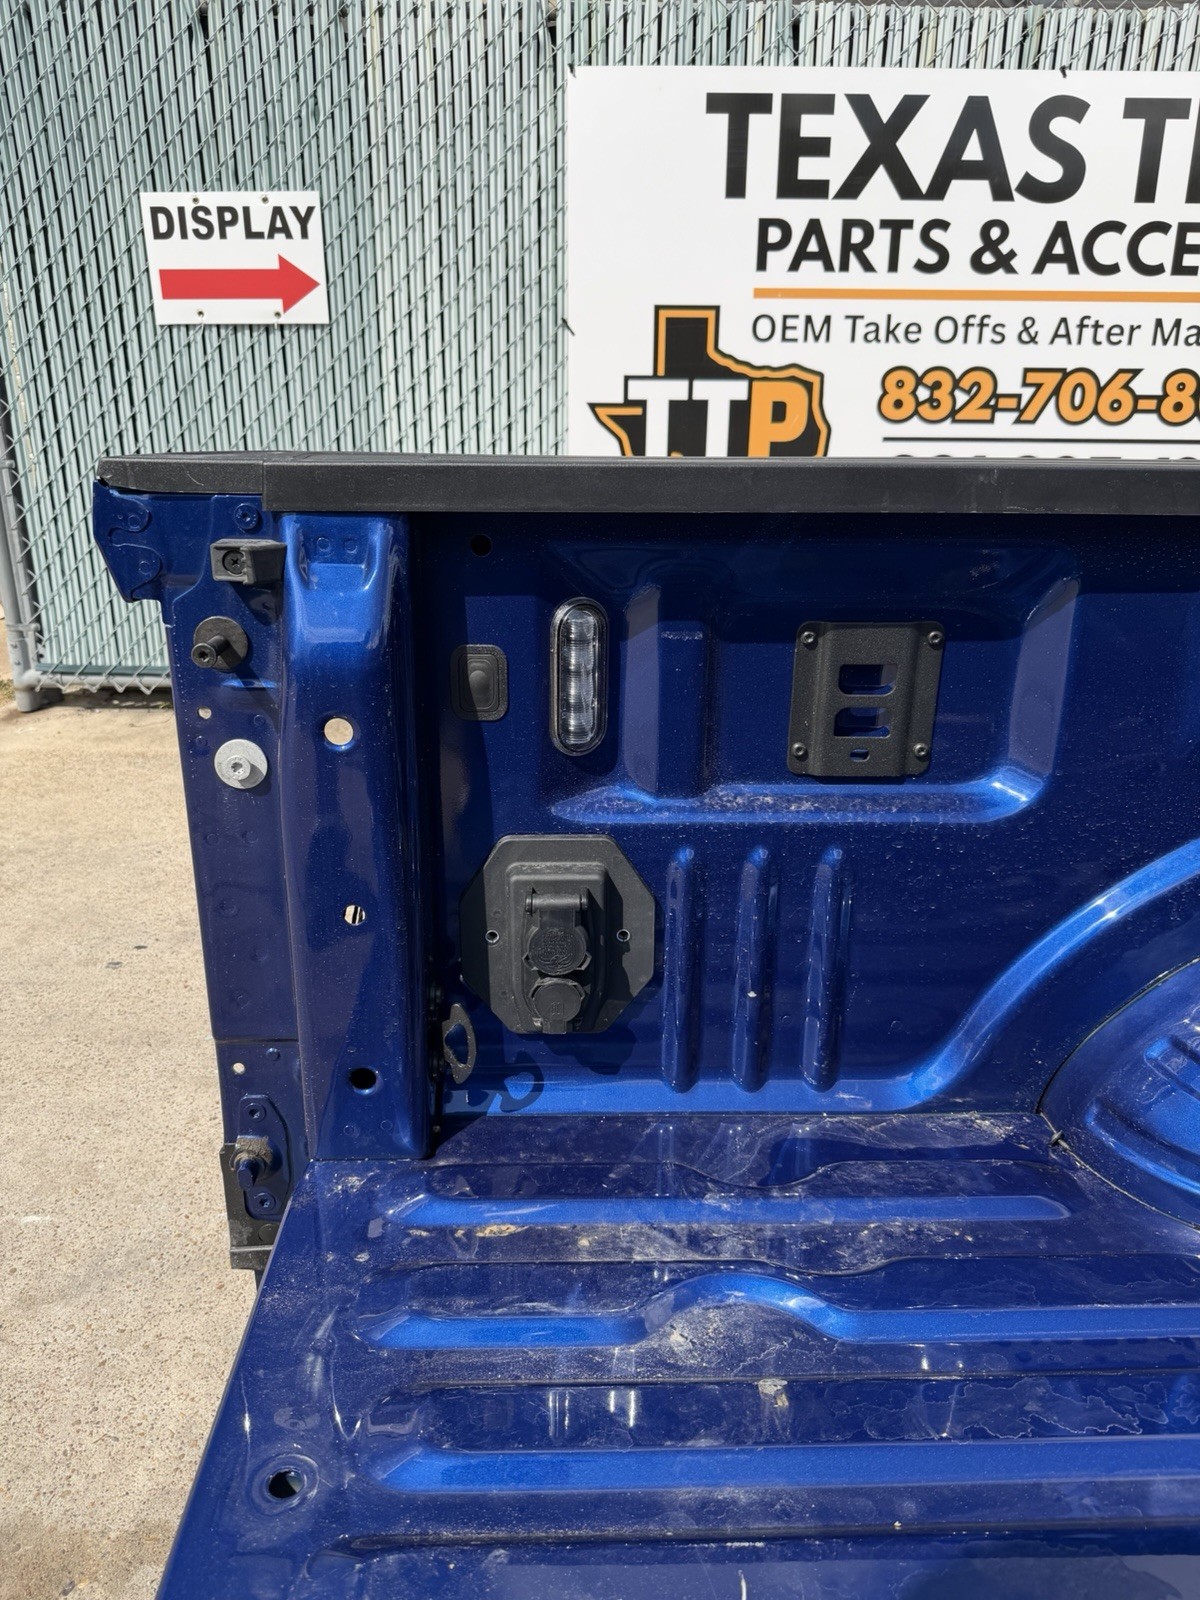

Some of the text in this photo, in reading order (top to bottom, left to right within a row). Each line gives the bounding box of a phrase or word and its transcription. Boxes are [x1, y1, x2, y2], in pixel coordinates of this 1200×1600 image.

[705, 92, 1200, 204] TEXAS T
[149, 205, 316, 240] DISPLAY
[756, 217, 1200, 277] PARTS & ACCE
[752, 314, 1200, 347] OEM Take Offs & After Ma
[624, 377, 809, 457] TTP
[877, 365, 1200, 427] 832-706-8
